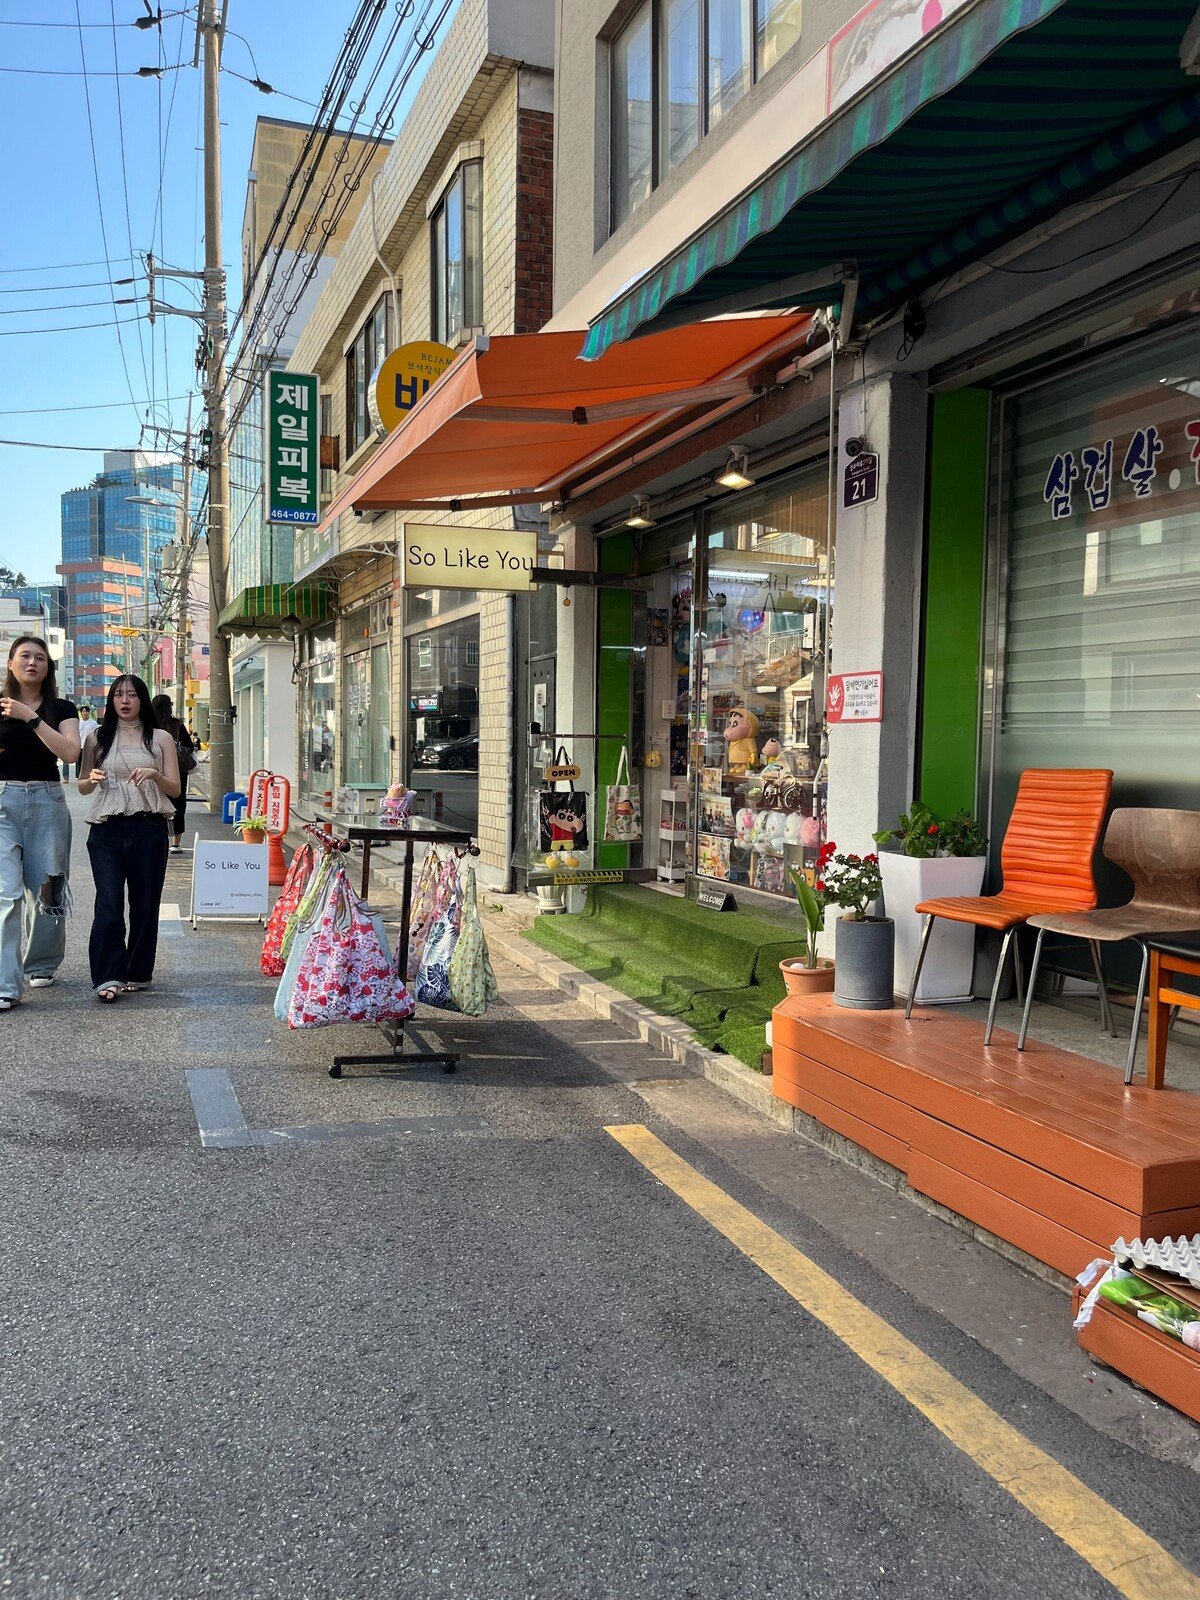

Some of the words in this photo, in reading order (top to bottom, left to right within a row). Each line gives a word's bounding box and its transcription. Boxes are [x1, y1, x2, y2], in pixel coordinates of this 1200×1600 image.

[275, 383, 311, 504] 제일피복
[852, 478, 866, 500] 21
[270, 509, 317, 521] 464-0877
[409, 545, 436, 567] So
[443, 547, 489, 569] Like
[496, 550, 533, 571] You
[551, 768, 576, 778] OPEN
[204, 860, 216, 870] So
[221, 861, 240, 870] Like
[244, 861, 261, 870] You
[699, 892, 724, 906] WELCOME
